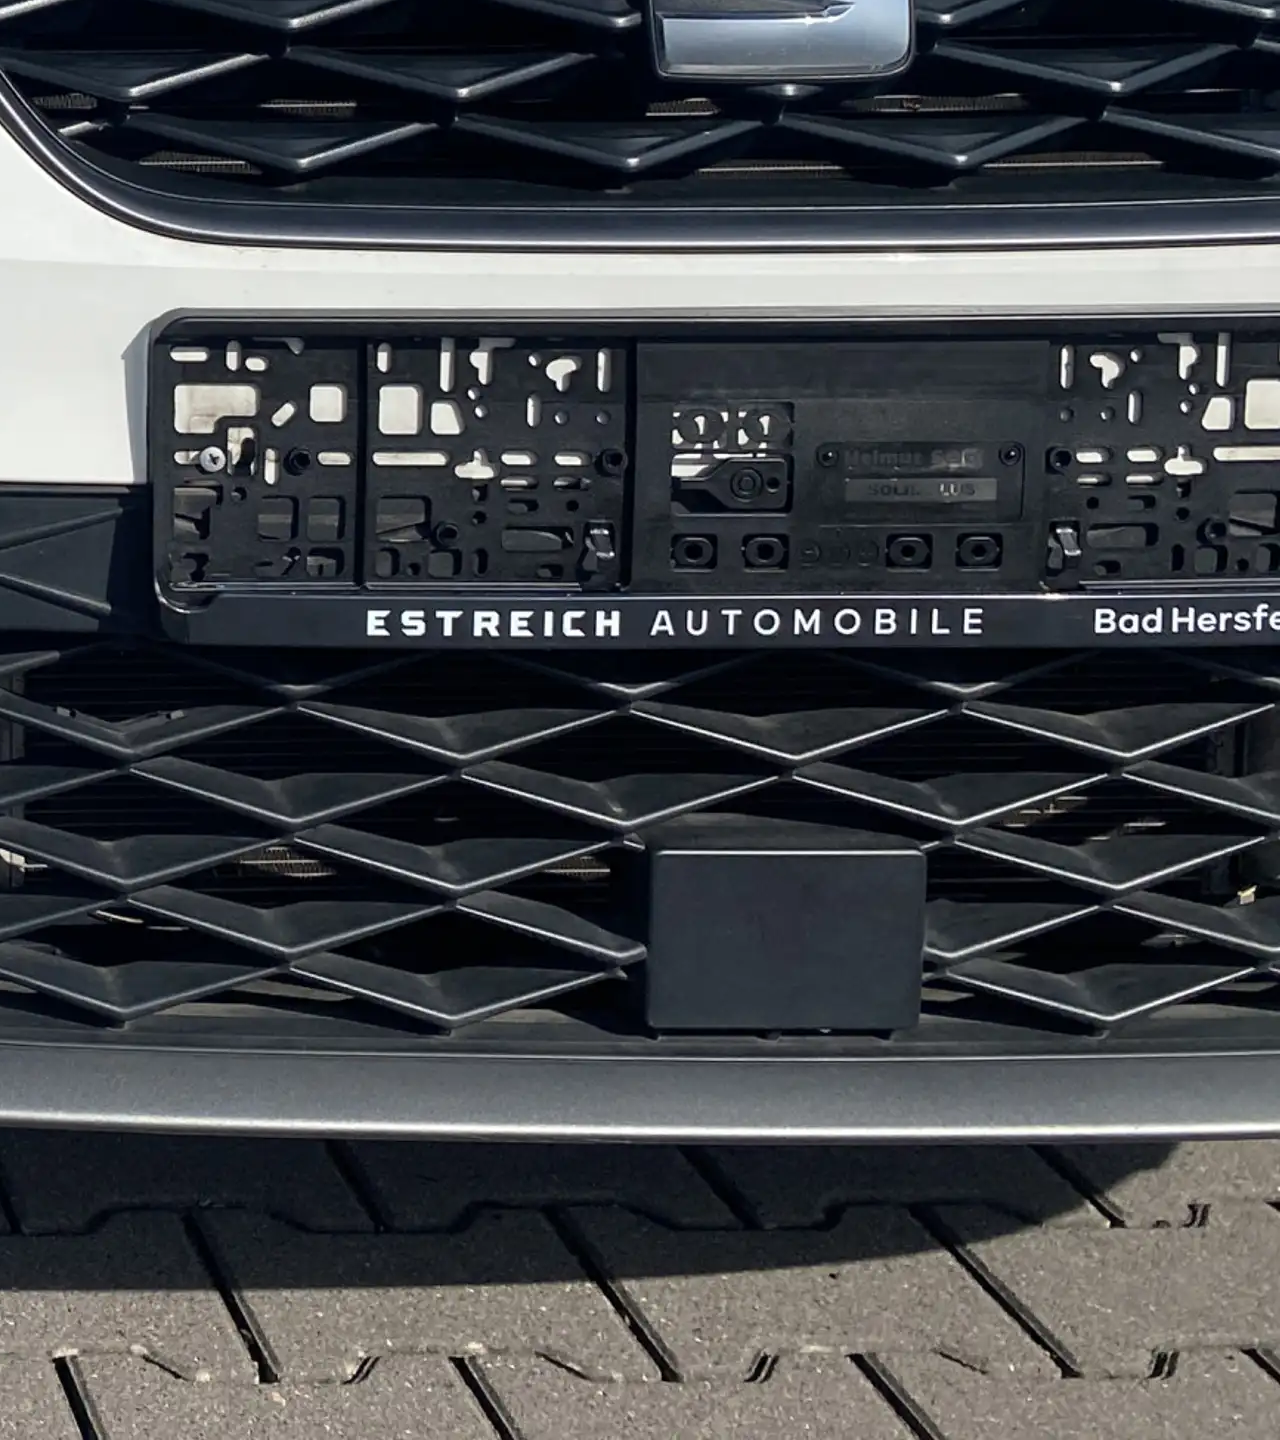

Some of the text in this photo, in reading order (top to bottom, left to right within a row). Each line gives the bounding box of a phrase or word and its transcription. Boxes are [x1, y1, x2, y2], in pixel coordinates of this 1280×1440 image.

[367, 608, 983, 636] ESTREICH AUTOMOBILE
[1095, 607, 1162, 633] Bad
